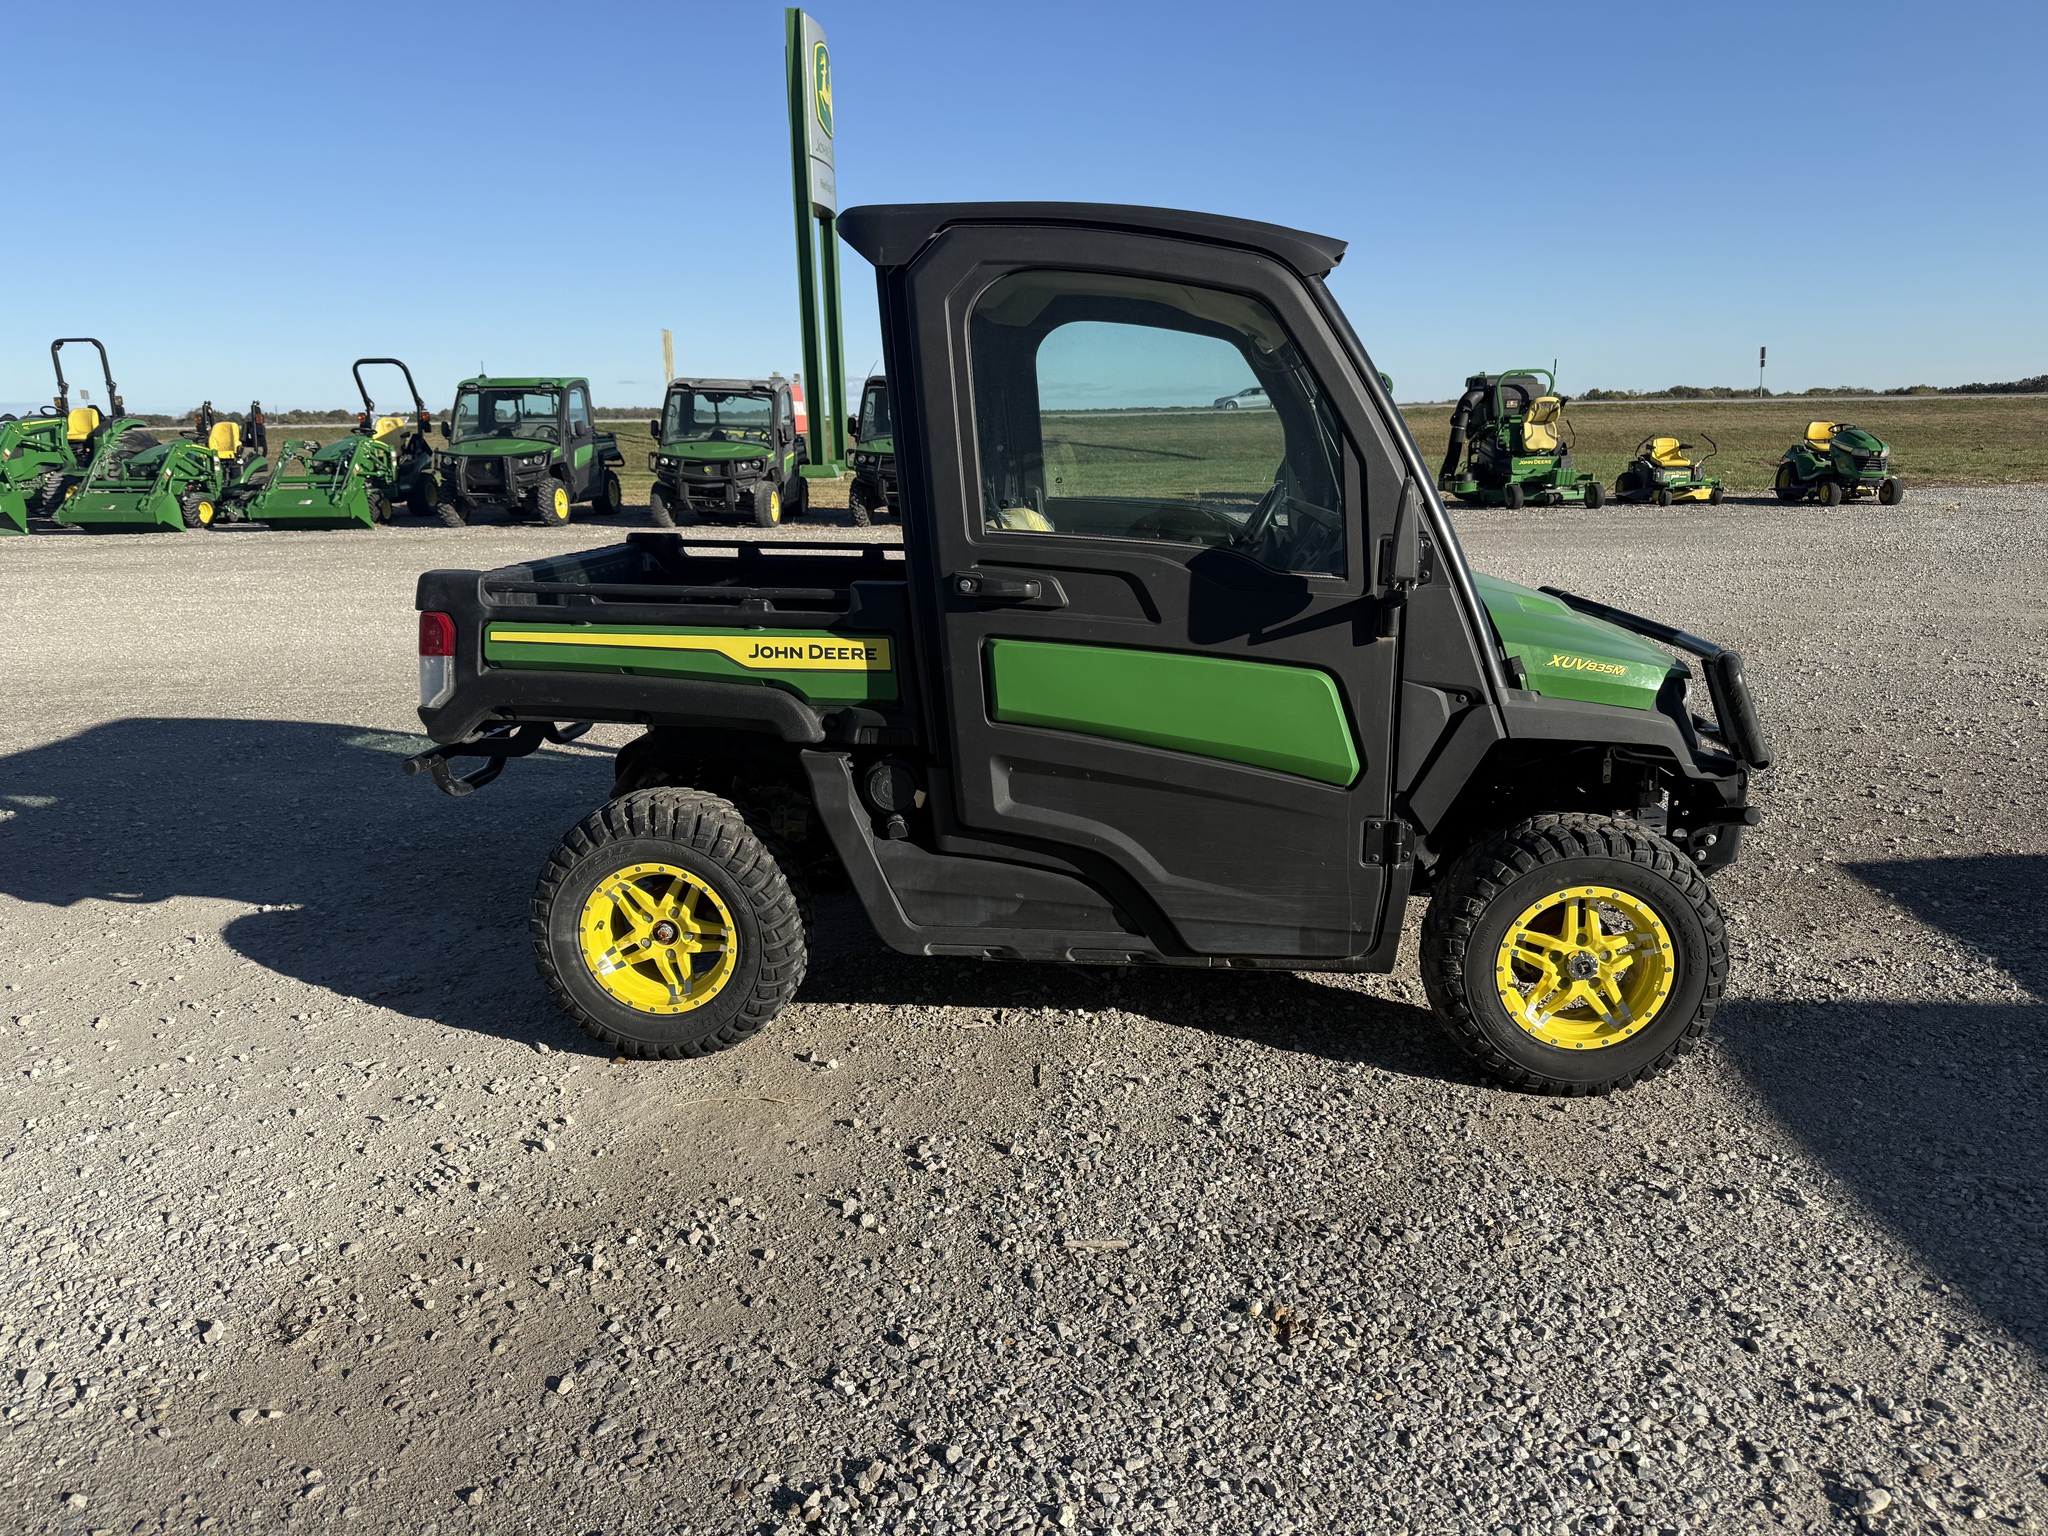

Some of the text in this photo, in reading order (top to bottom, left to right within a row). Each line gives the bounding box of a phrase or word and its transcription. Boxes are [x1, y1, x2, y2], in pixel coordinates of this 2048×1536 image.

[748, 642, 878, 661] JOHN DEERE
[1546, 654, 1627, 676] XUV835M
